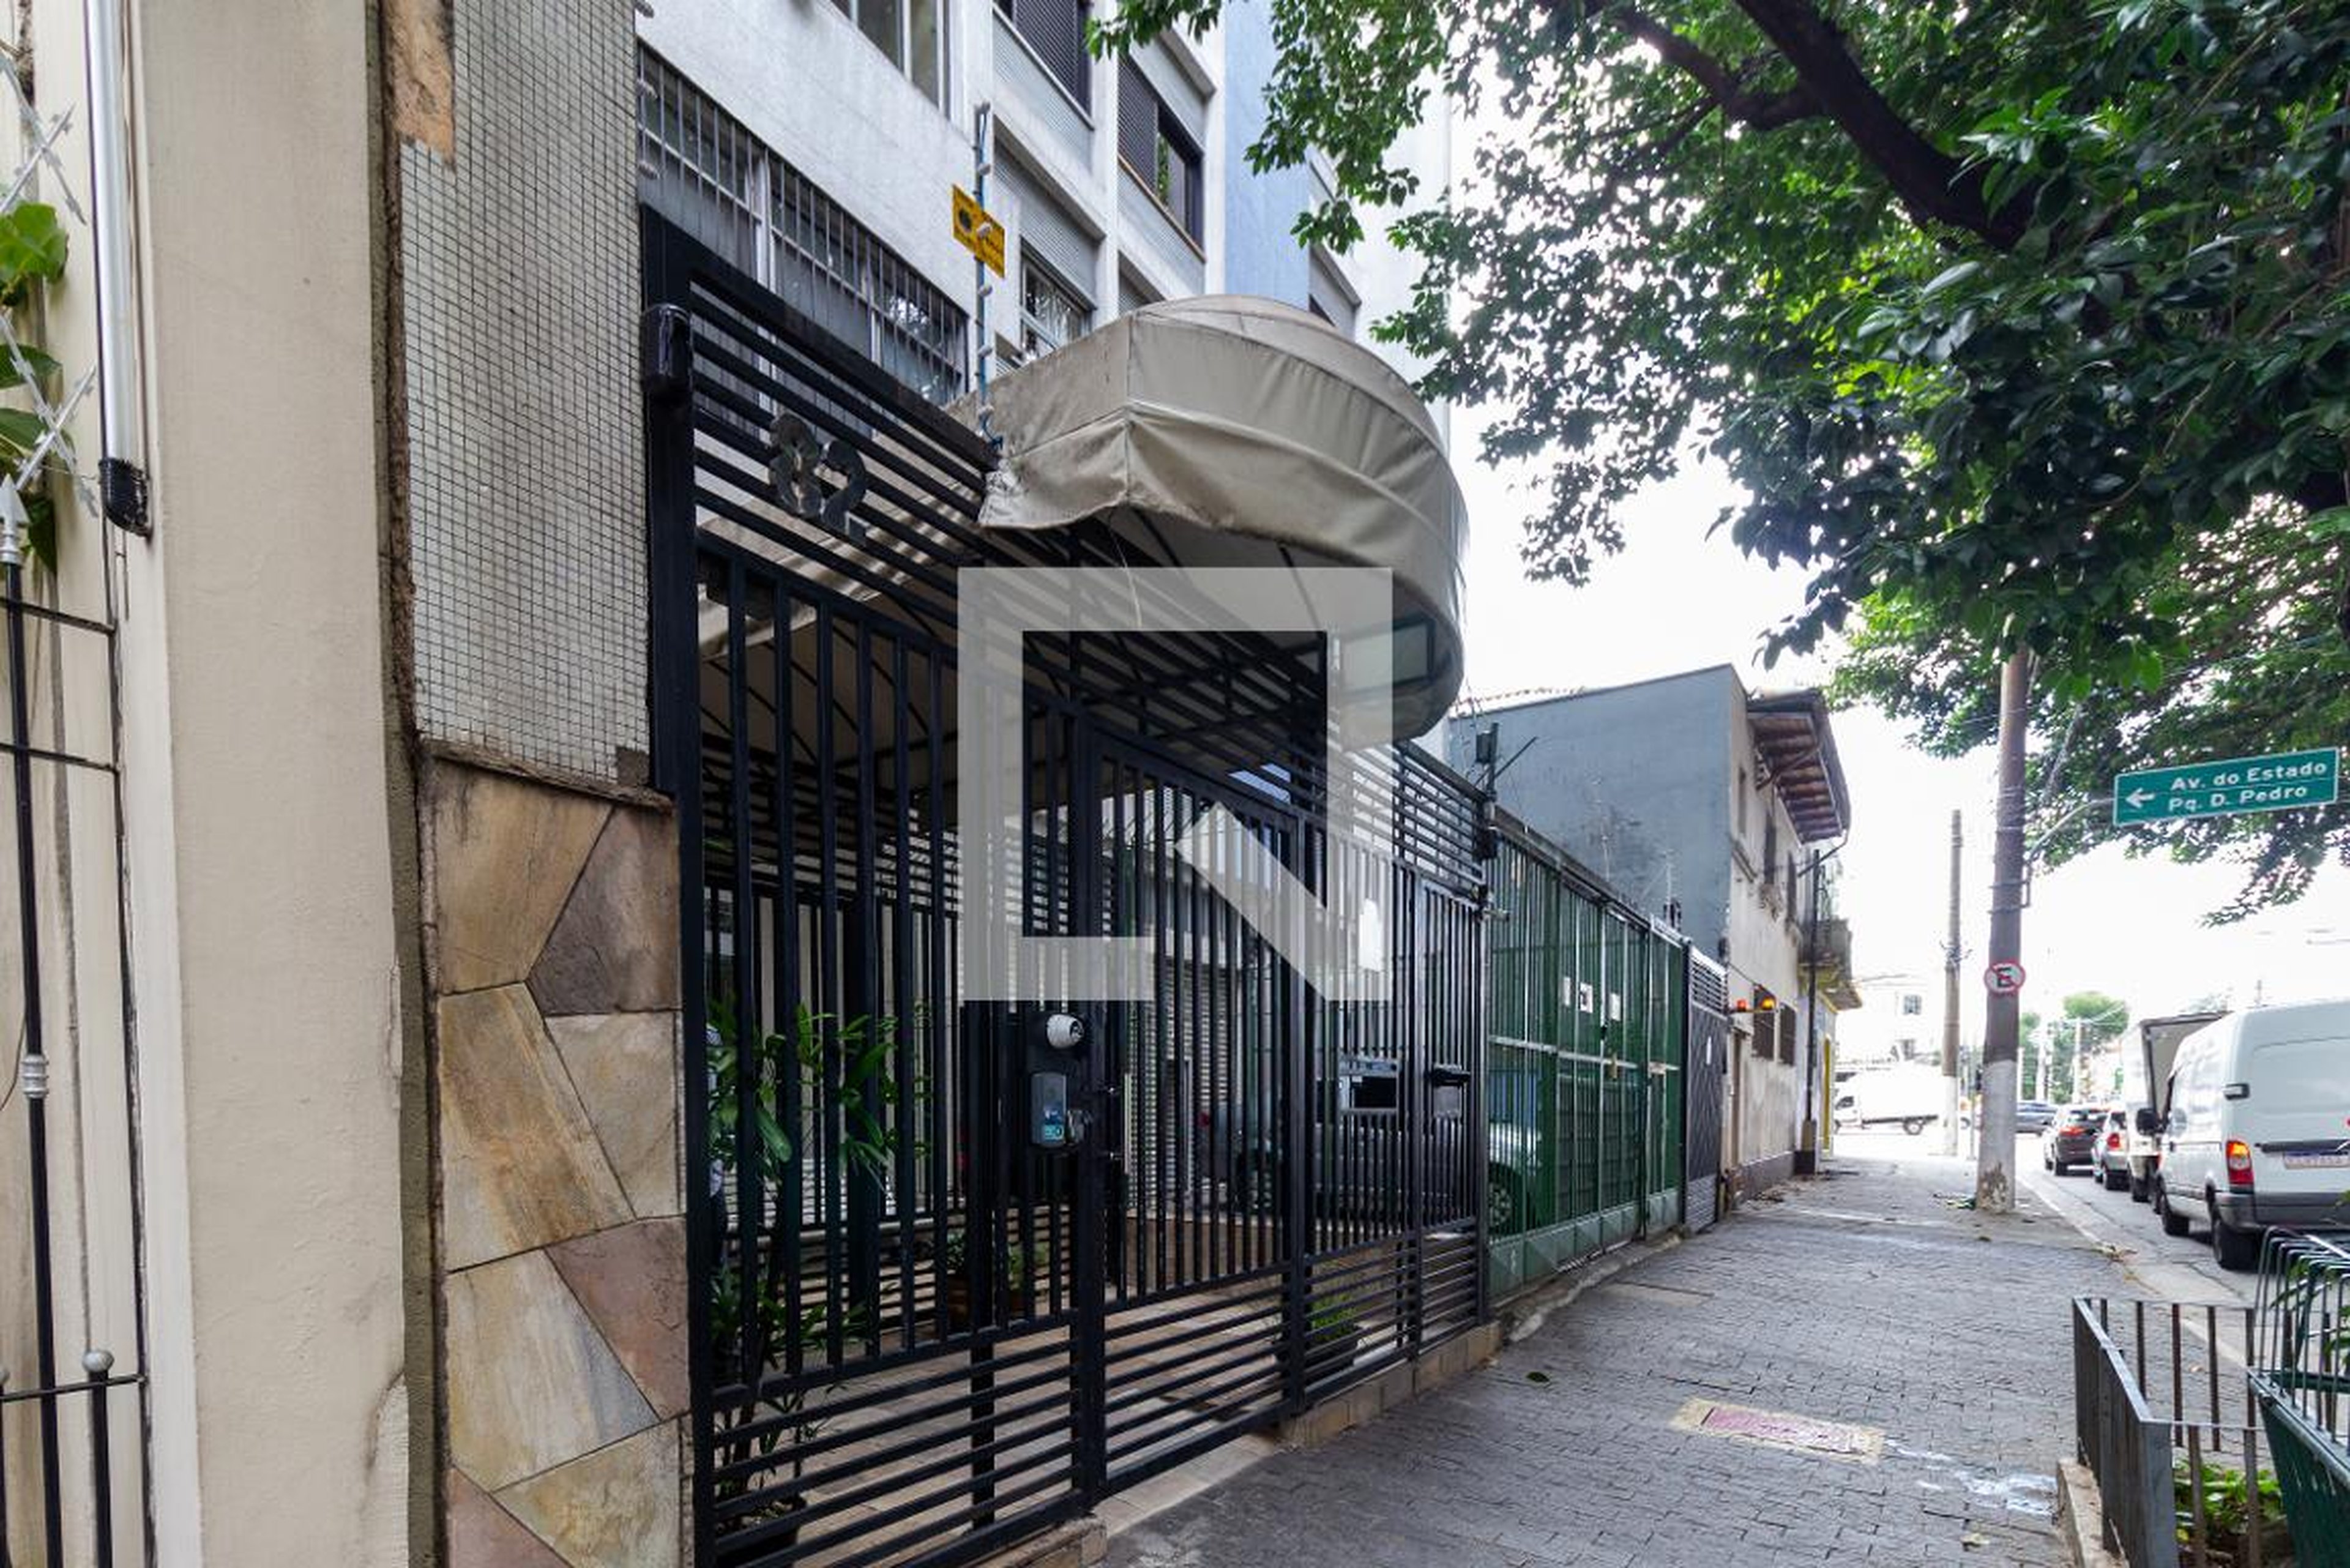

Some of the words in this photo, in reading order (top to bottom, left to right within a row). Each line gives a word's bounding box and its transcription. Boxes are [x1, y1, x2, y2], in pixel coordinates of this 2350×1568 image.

[2171, 776, 2206, 791] Av.
[2213, 772, 2239, 786] do
[2247, 761, 2327, 782] Estado
[2168, 797, 2203, 812] Pq.
[2210, 793, 2231, 807] D.
[2239, 785, 2307, 804] Pedro
[1996, 967, 2015, 988] E
